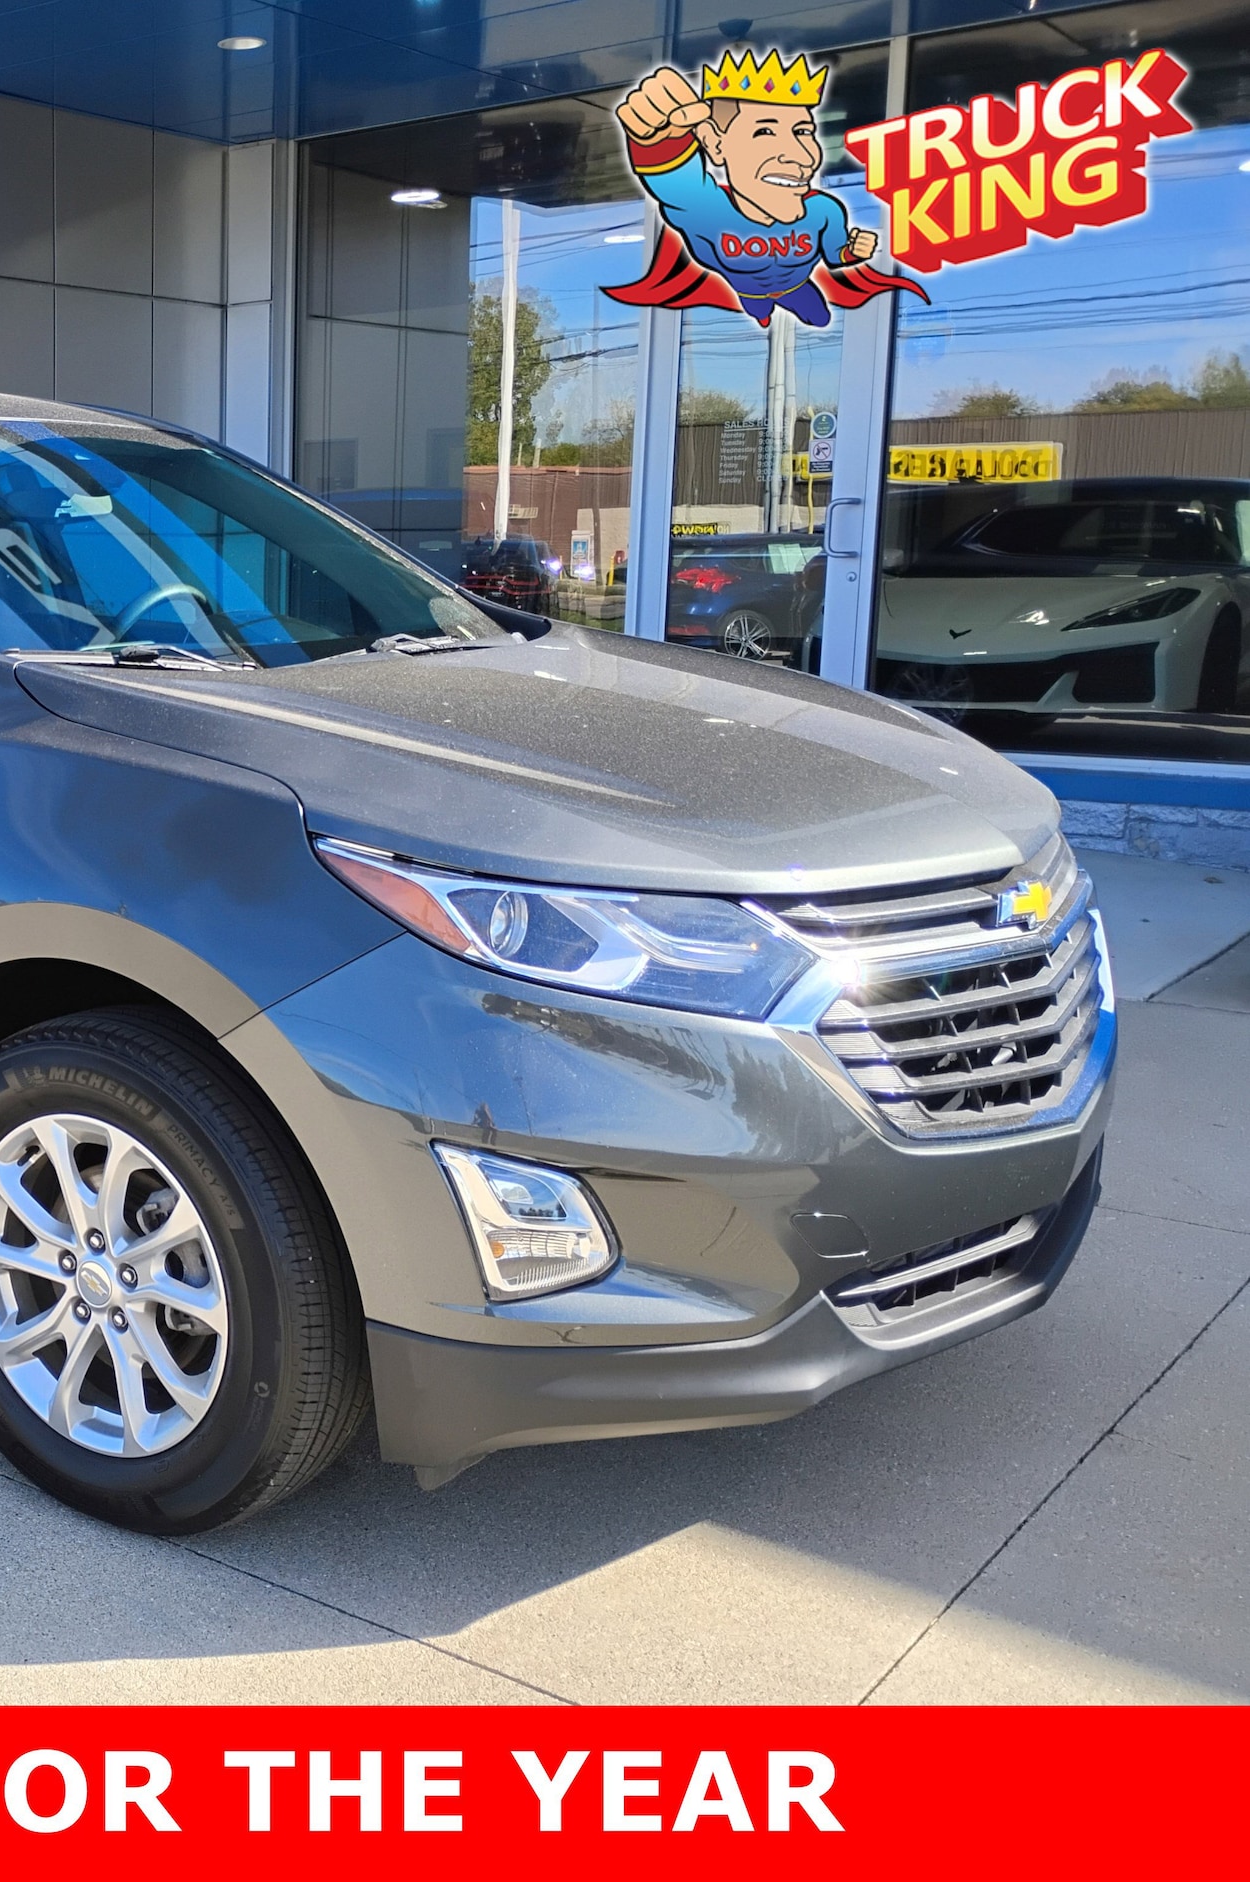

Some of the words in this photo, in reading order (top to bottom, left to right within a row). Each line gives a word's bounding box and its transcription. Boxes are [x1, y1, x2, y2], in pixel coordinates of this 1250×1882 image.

[721, 432, 745, 440] Monday
[724, 420, 754, 429] SALES
[50, 1066, 154, 1117] MICHELIN
[166, 1124, 221, 1188] PRIMACY
